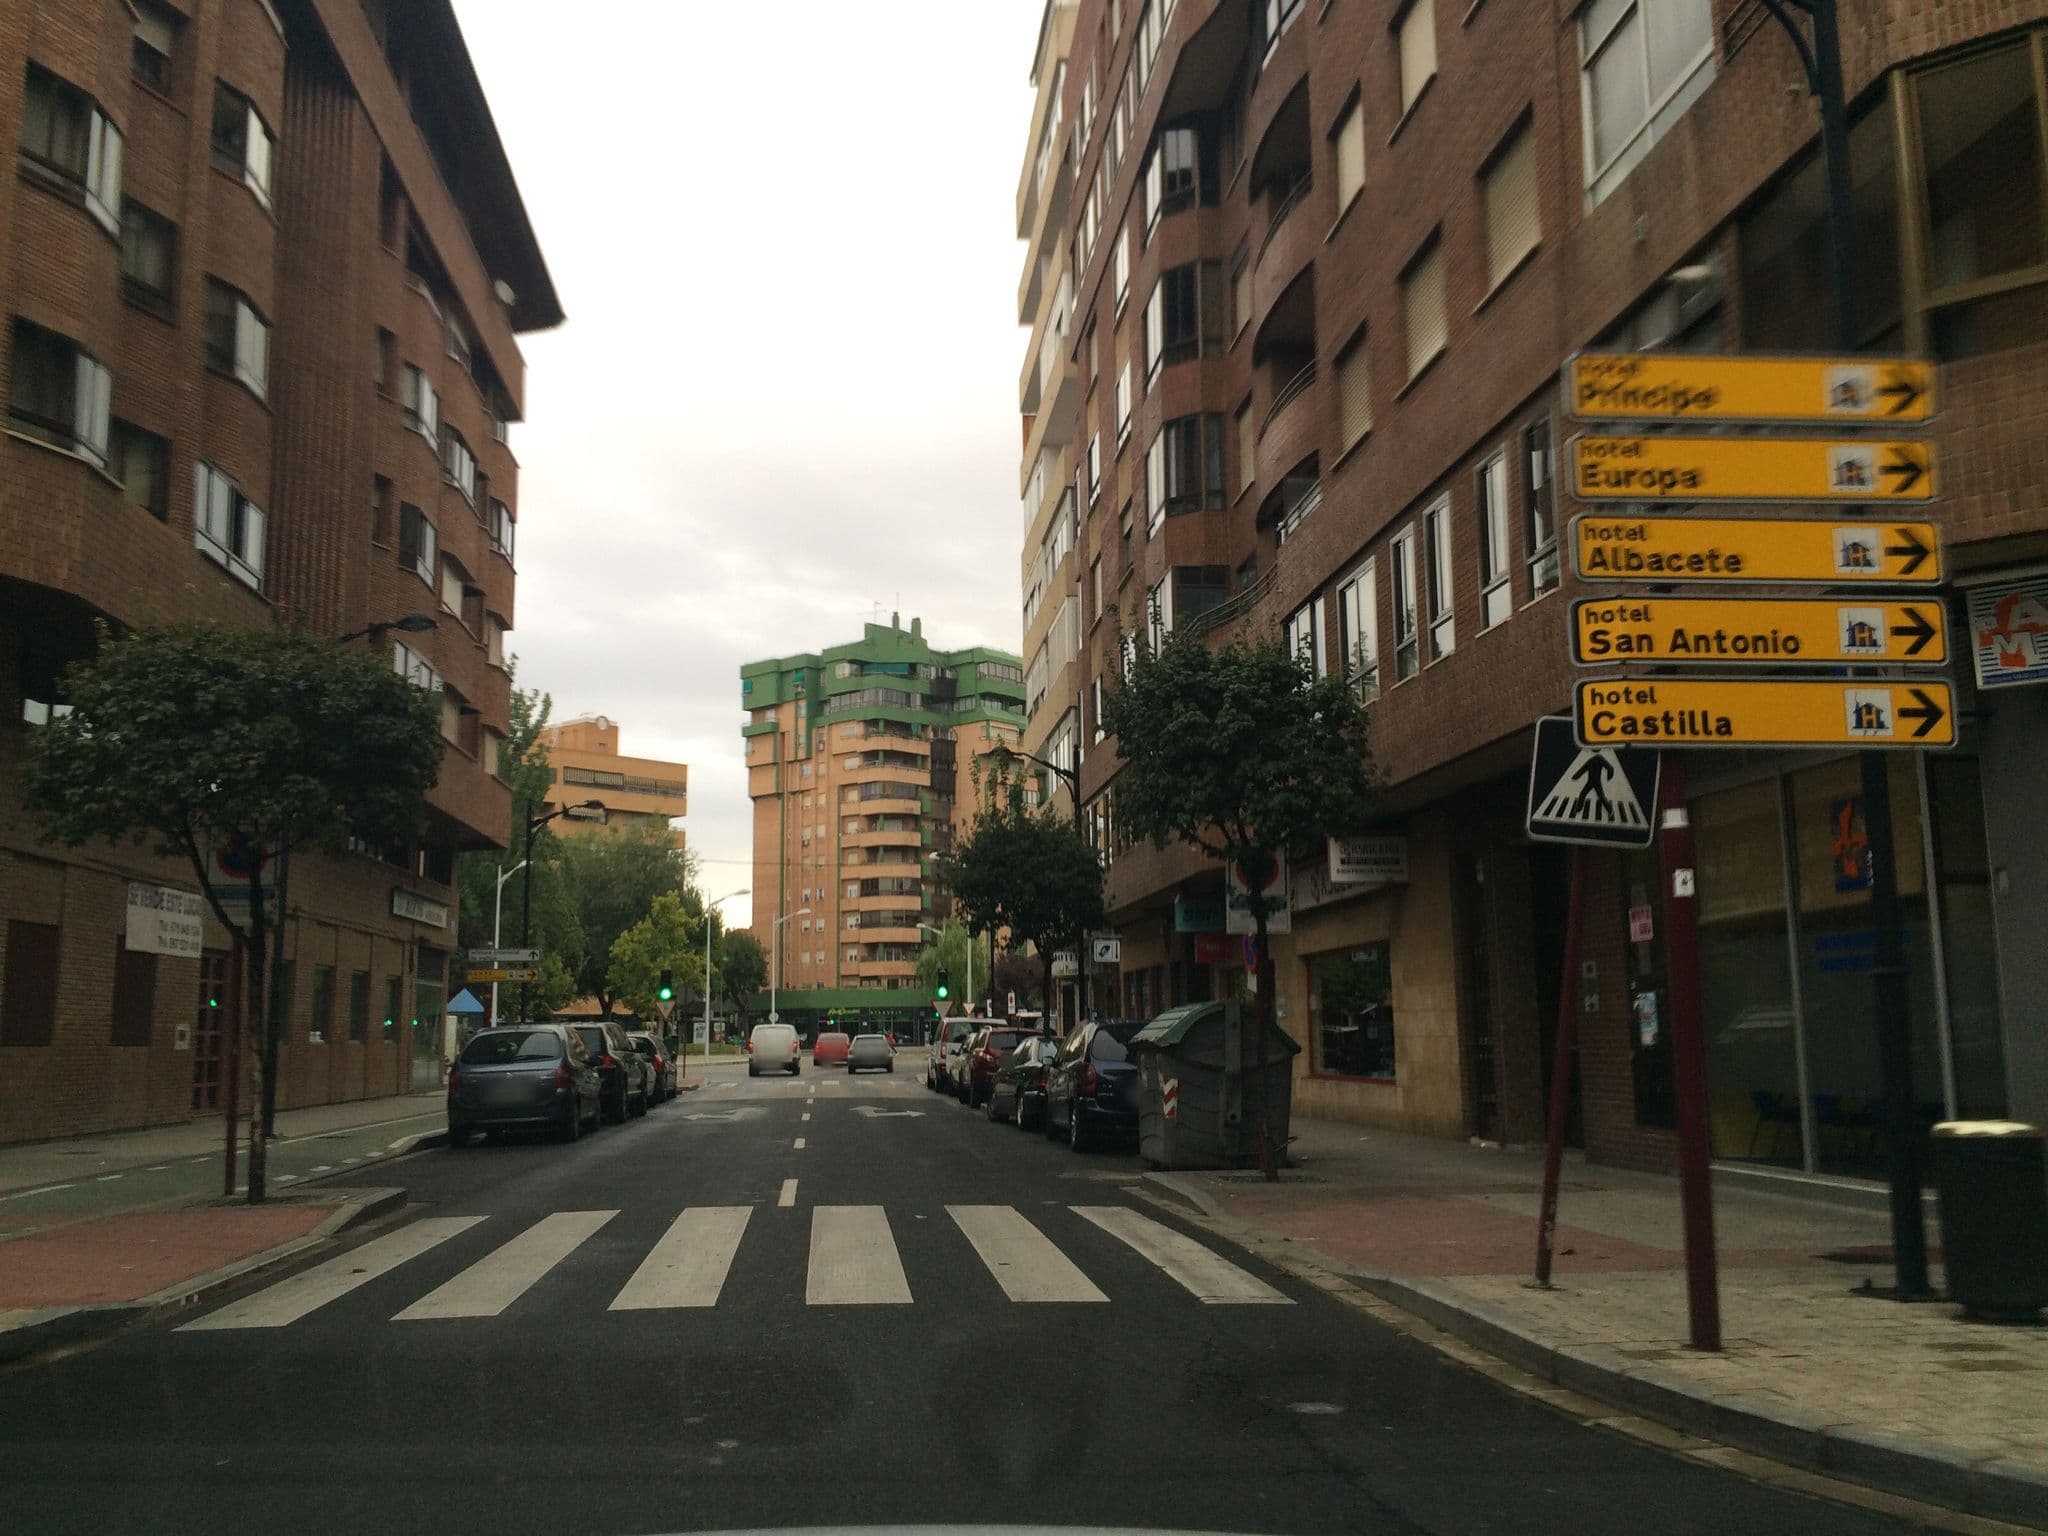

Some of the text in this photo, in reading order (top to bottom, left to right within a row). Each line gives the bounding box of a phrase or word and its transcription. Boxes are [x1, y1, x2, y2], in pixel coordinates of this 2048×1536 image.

[1581, 440, 1641, 458] hotel
[1581, 463, 1701, 495] Europa
[1584, 524, 1648, 541] hotel
[1587, 547, 1743, 573] Albacete
[1584, 605, 1653, 624] hotel
[1588, 628, 1801, 655] San Antonio
[1590, 686, 1658, 705] hotel
[1591, 710, 1734, 737] Castilla
